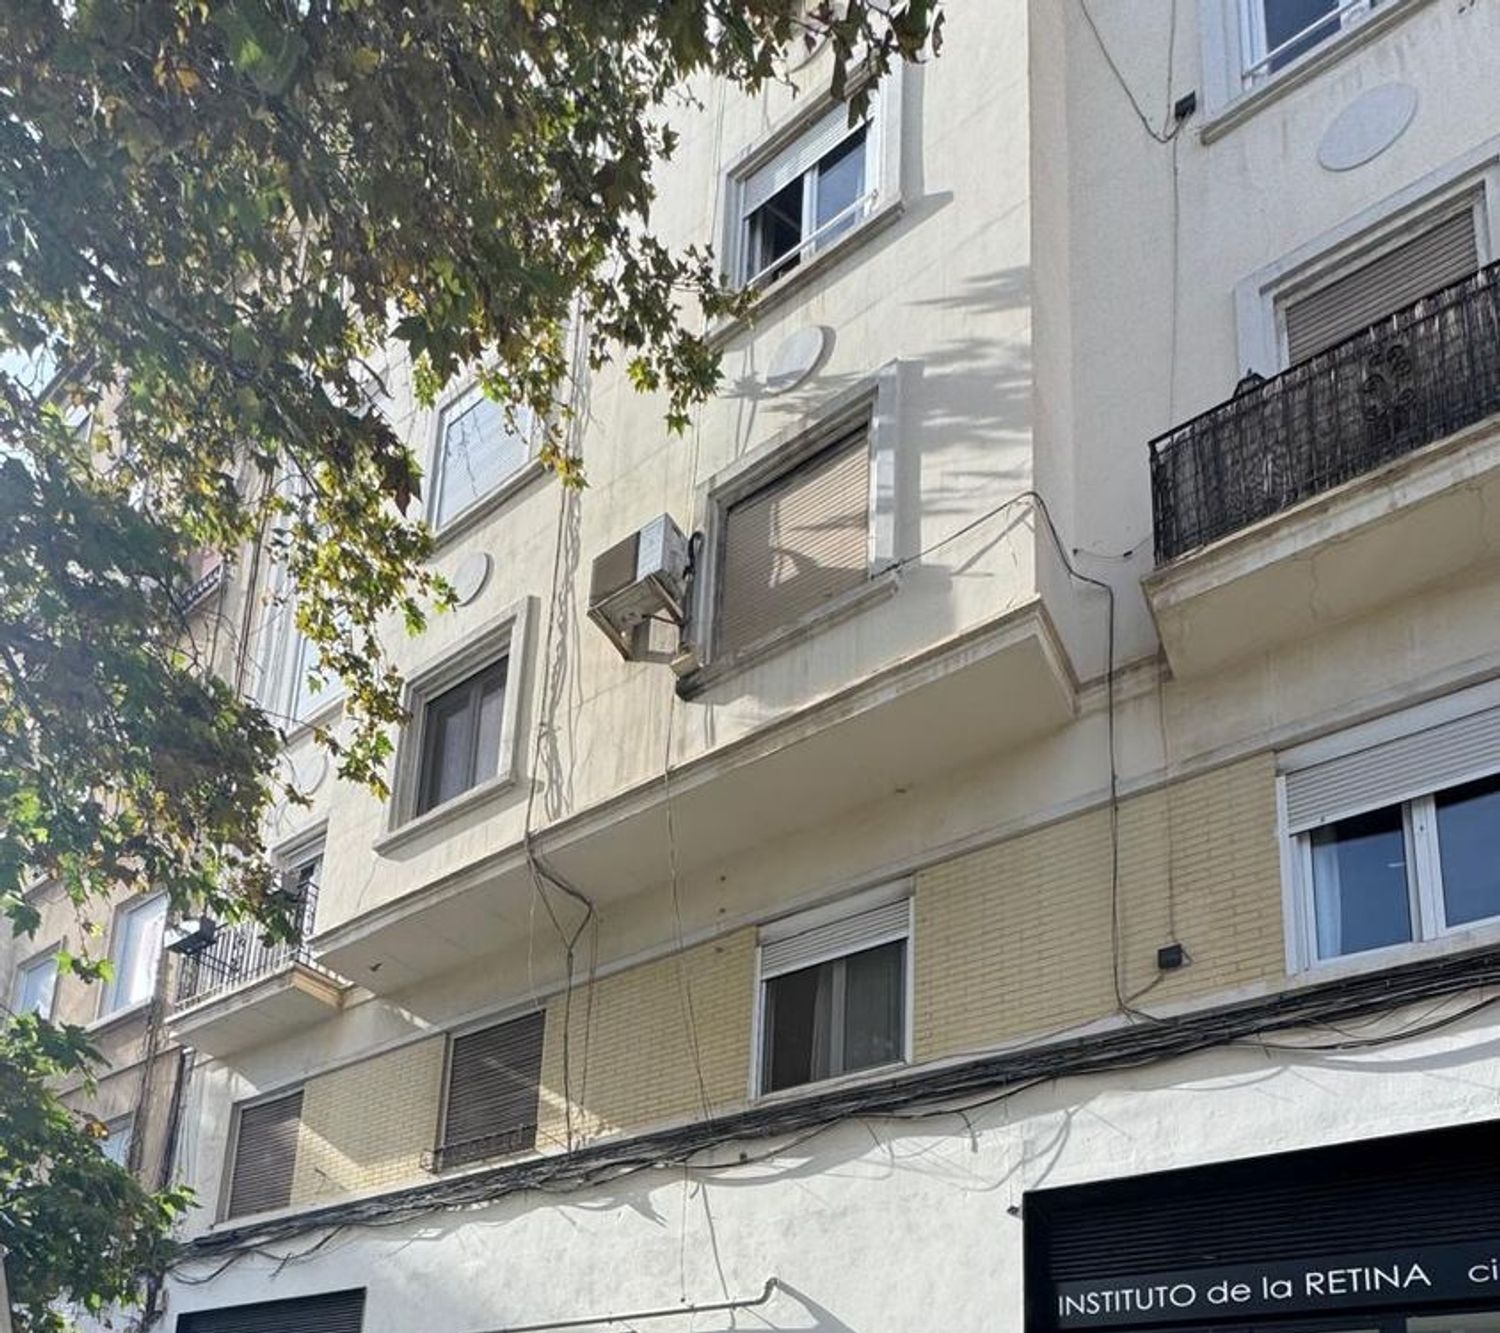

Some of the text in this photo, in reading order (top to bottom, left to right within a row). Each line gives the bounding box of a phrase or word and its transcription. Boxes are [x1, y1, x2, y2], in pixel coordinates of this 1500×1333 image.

[1058, 1283, 1196, 1317] INSTITUTO
[1207, 1280, 1251, 1304] de
[1262, 1276, 1293, 1299] la
[1305, 1263, 1432, 1296] RETINA
